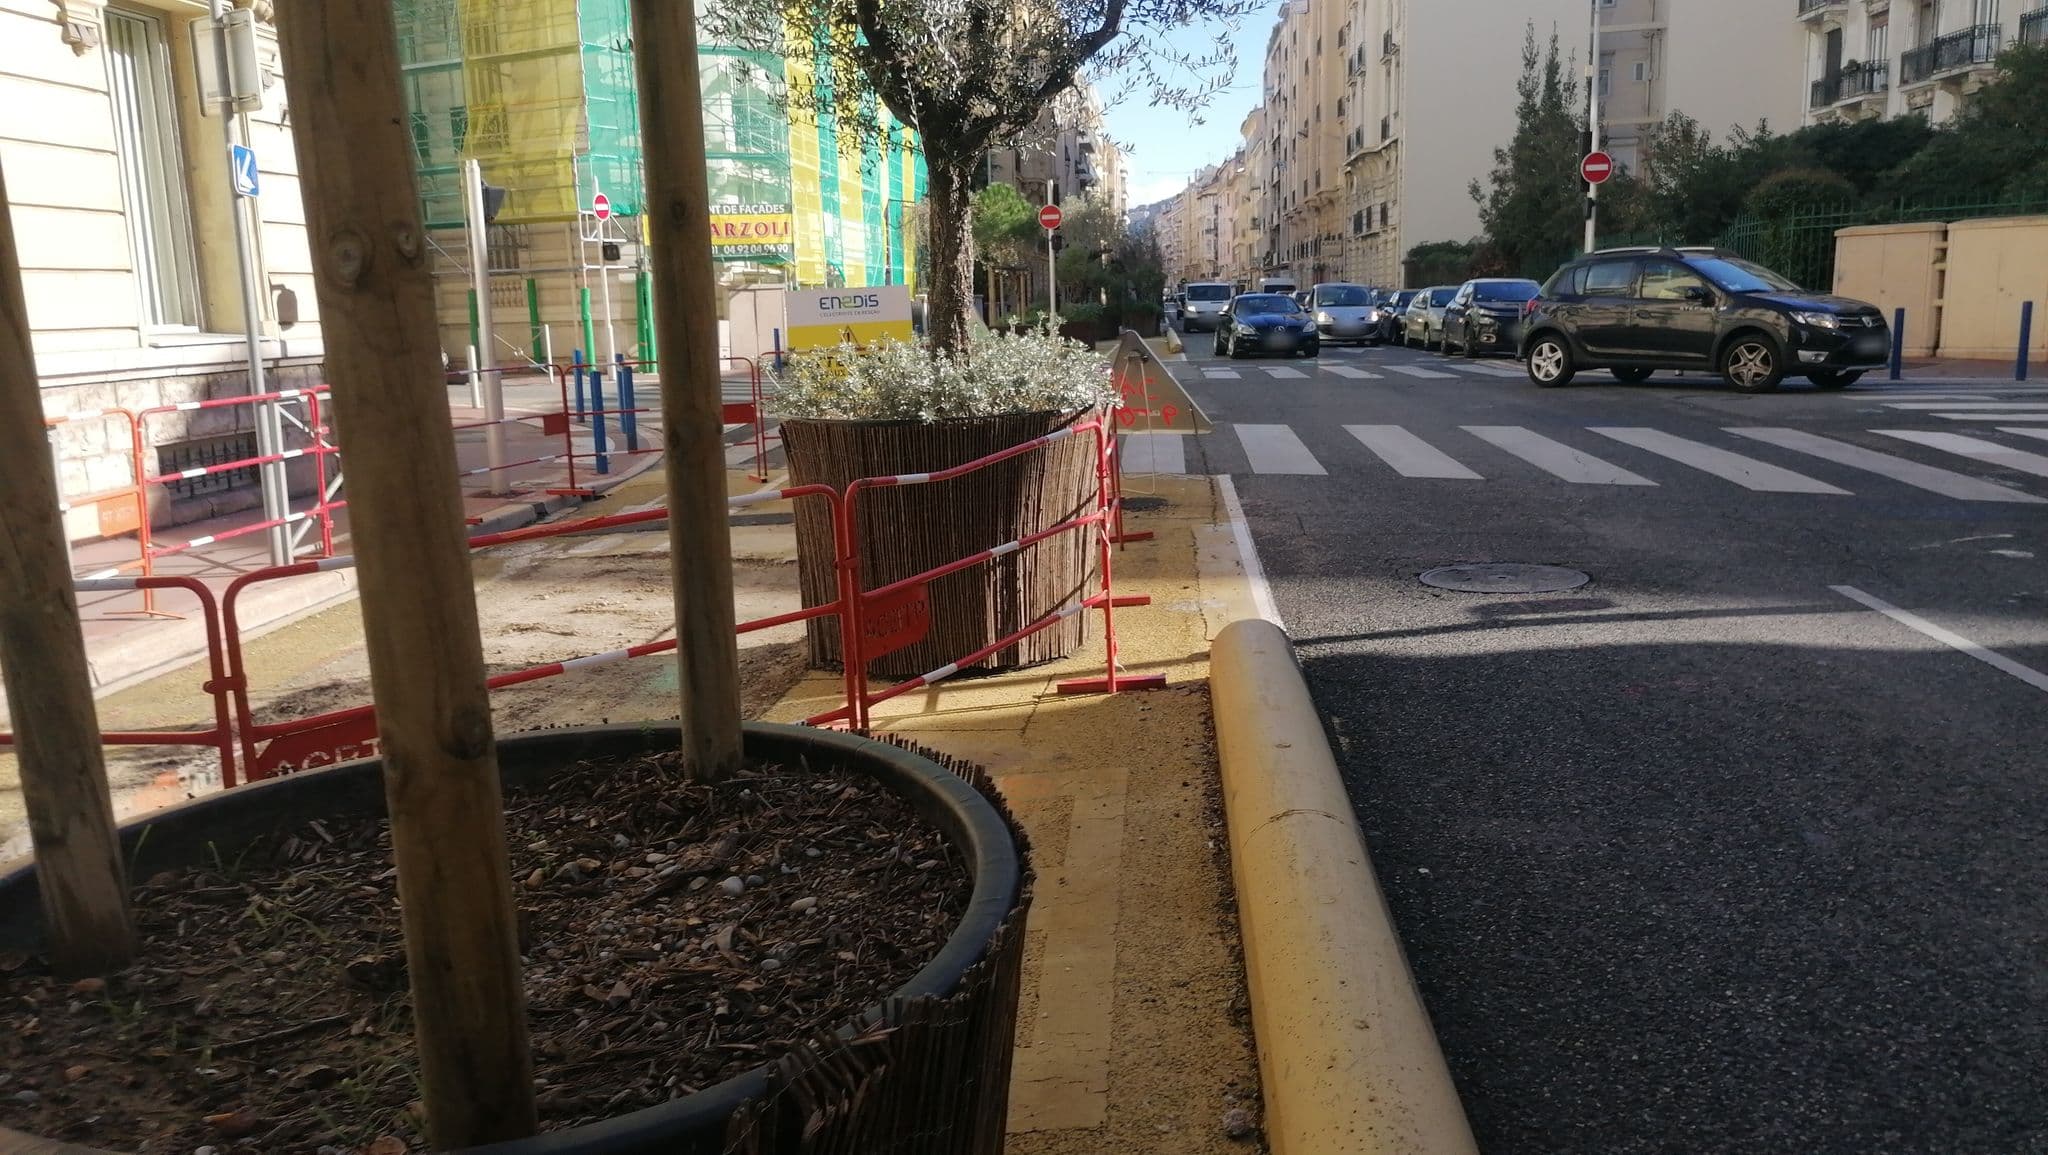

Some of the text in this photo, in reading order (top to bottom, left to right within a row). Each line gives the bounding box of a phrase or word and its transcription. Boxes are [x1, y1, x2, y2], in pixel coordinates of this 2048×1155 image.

[709, 204, 785, 216] NT DE FAÇADES
[711, 222, 788, 237] ARZOLI
